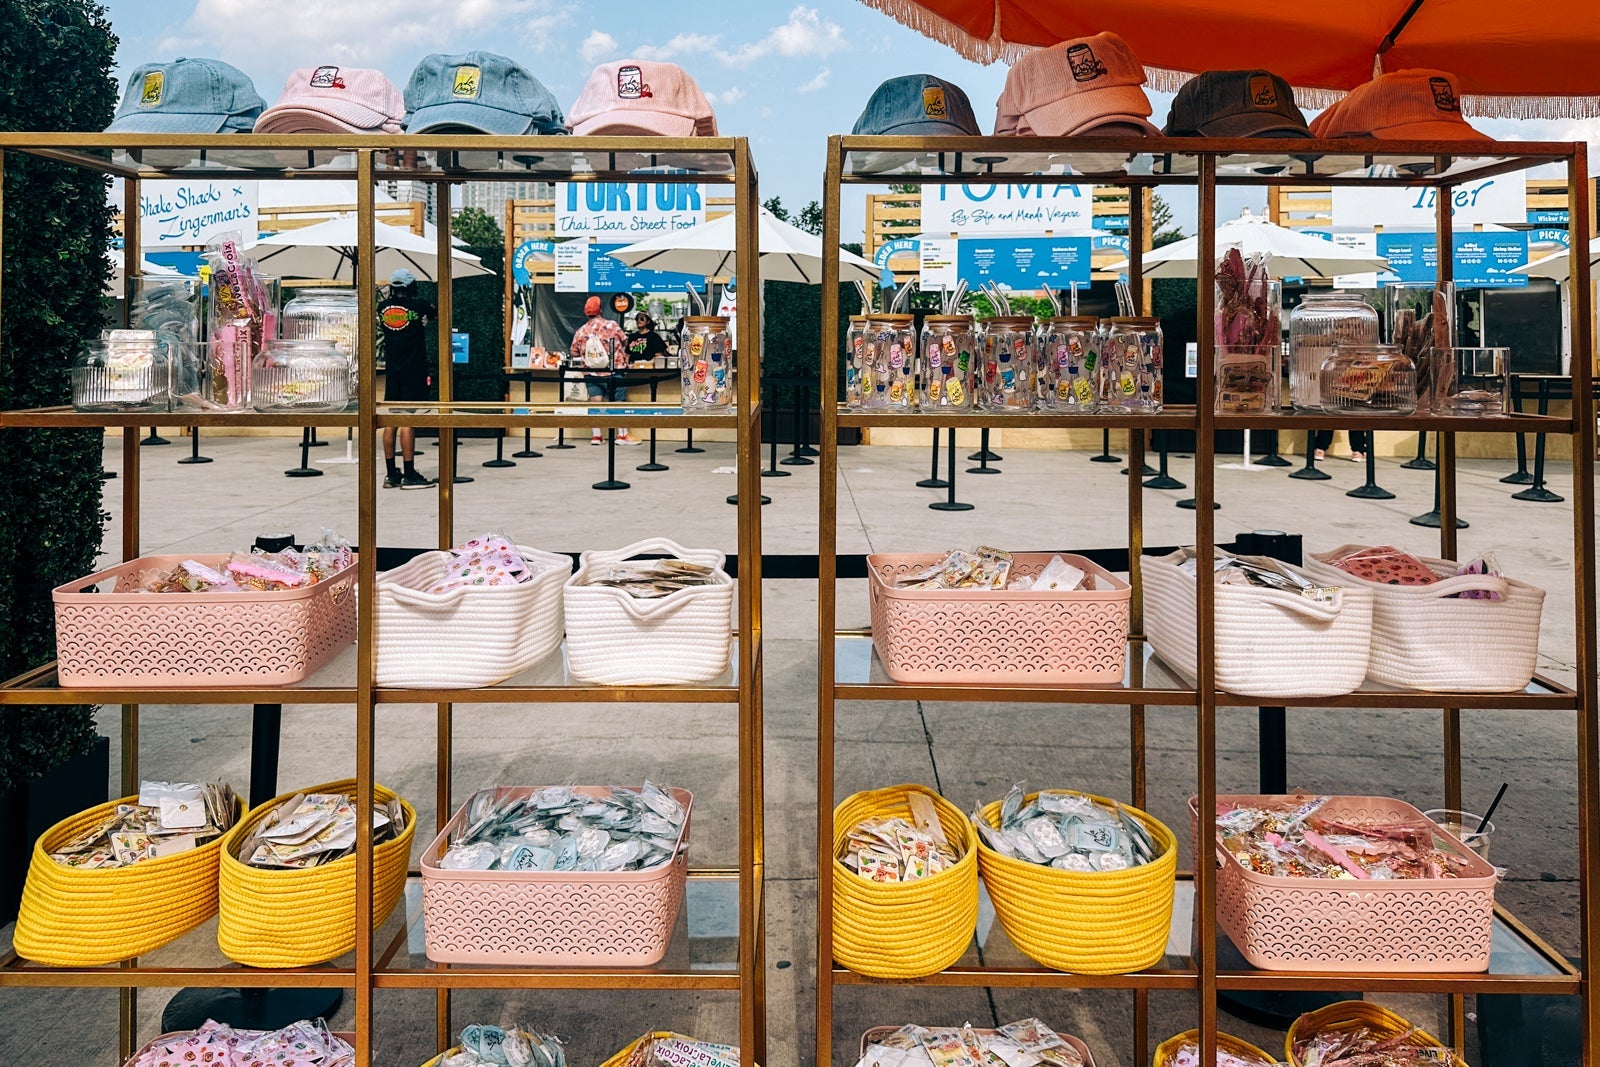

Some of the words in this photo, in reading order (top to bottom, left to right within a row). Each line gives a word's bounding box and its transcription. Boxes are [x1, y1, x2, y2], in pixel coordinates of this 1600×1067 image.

[175, 184, 221, 210] Shack
[1405, 181, 1495, 219] Tier
[158, 203, 251, 241] Zingerman's
[559, 215, 590, 232] Thai
[631, 214, 668, 231] Street
[671, 214, 697, 231] Food
[950, 209, 970, 226] By
[997, 210, 1013, 220] and
[1102, 237, 1121, 247] PICK
[1538, 231, 1560, 241] PICK
[894, 241, 914, 251] HERE
[514, 245, 531, 269] ORDER
[531, 242, 549, 252] HERE
